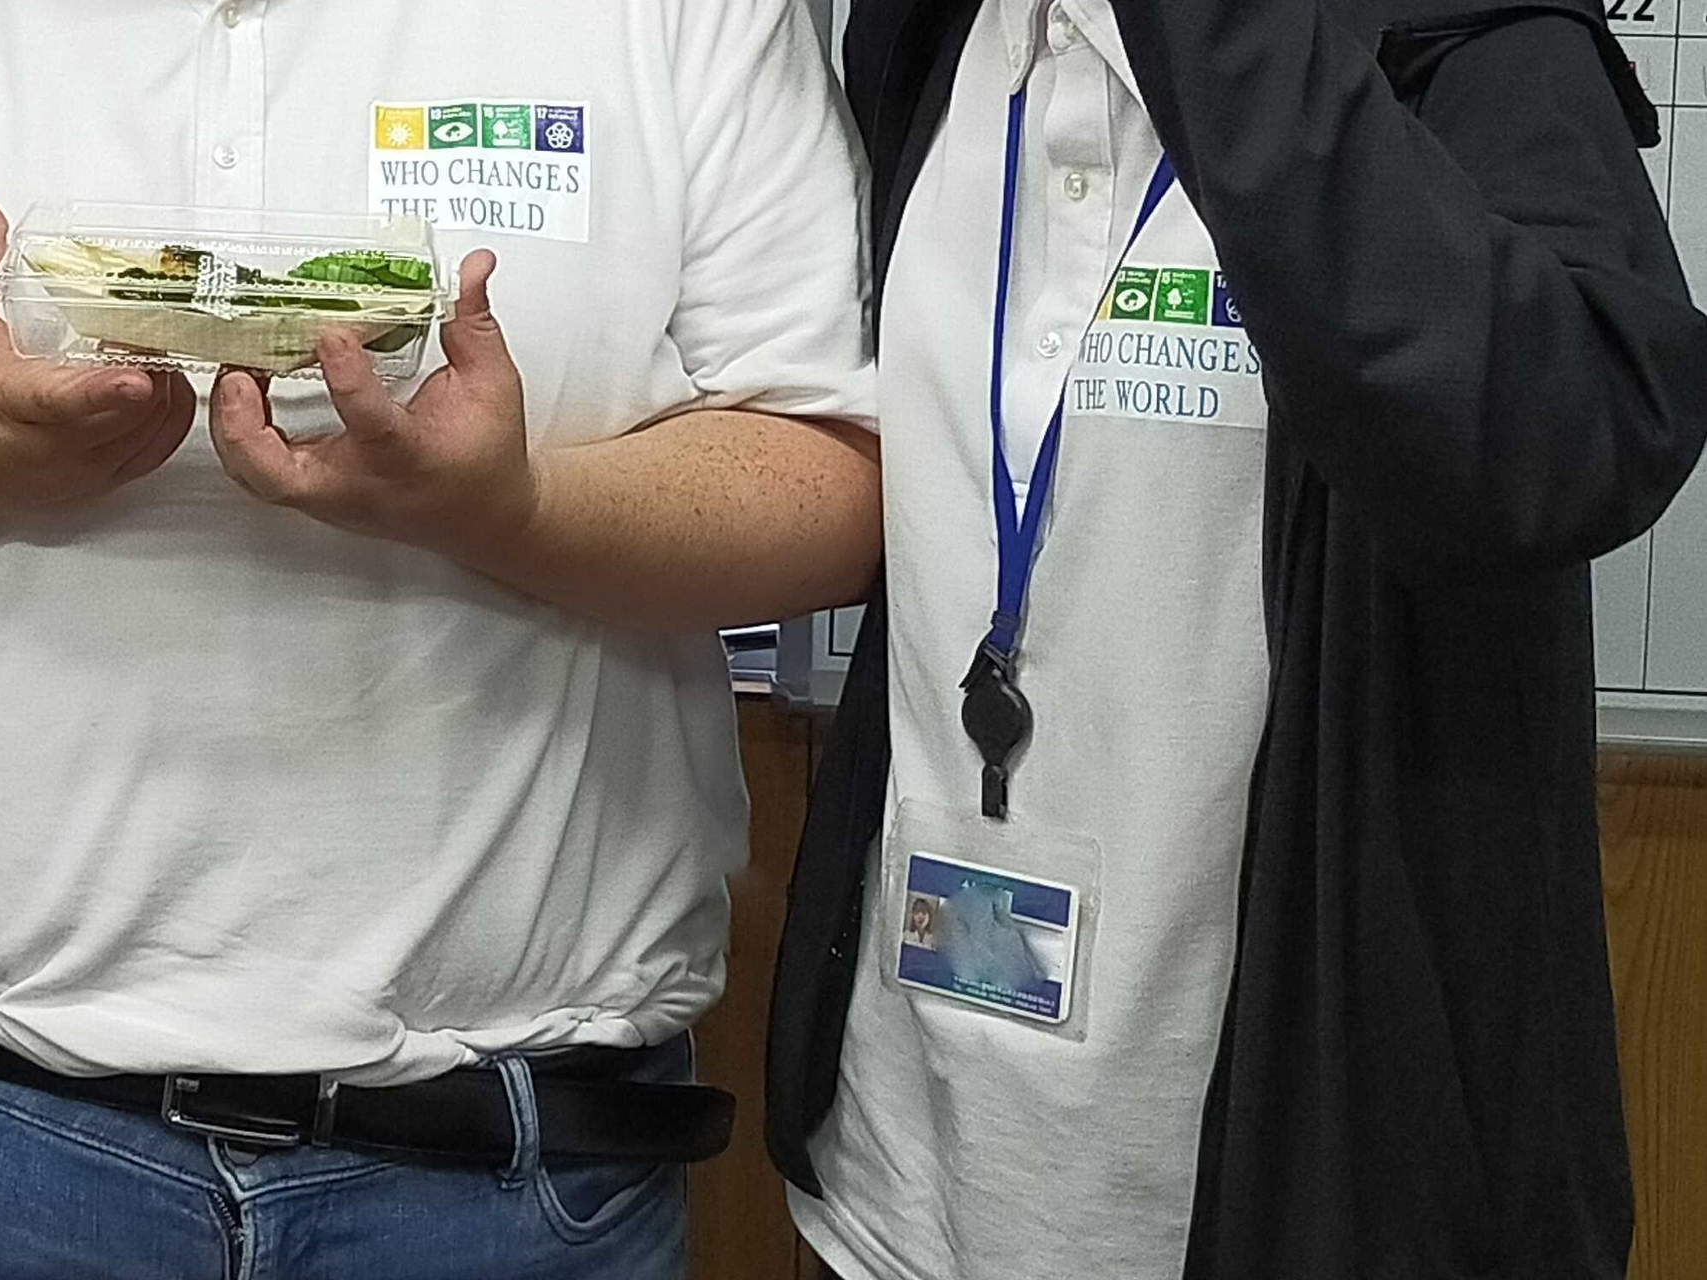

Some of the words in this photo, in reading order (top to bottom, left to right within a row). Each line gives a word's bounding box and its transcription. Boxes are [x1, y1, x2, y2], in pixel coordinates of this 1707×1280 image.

[380, 160, 439, 186] WHO
[448, 158, 580, 194] CHANGES
[381, 198, 439, 223] THE
[449, 197, 545, 232] WORLD
[1118, 332, 1261, 375] CHANGES
[1074, 379, 1107, 410] THE
[1115, 380, 1219, 418] WORLD
